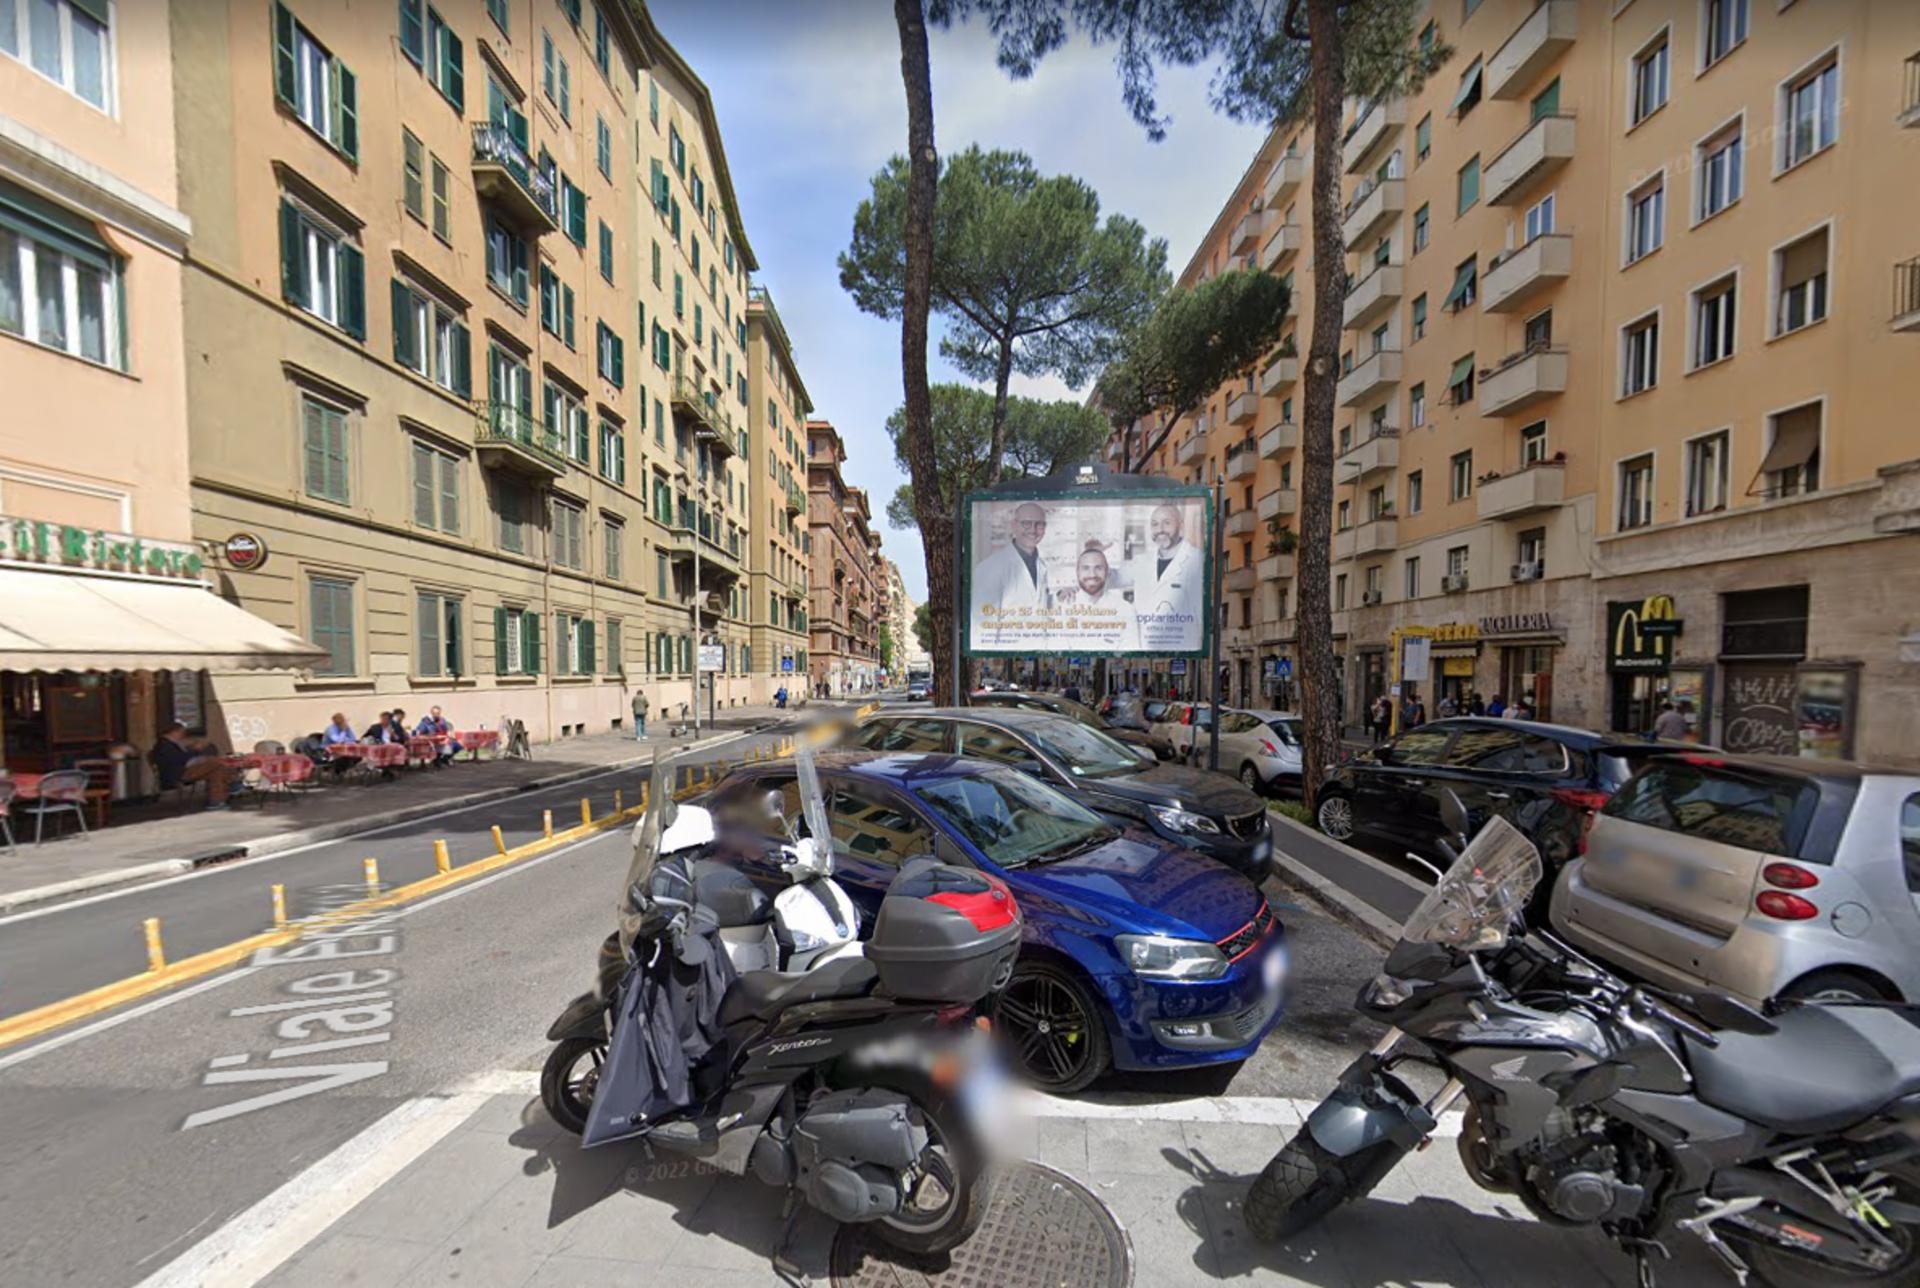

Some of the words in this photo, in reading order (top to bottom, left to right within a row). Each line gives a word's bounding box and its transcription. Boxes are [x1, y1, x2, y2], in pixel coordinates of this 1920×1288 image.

[15, 519, 48, 556] il
[63, 525, 203, 573] Ristoro
[981, 602, 1016, 619] Dopo
[1036, 606, 1061, 617] anni
[1065, 604, 1118, 617] abbiamo
[981, 620, 1024, 630] ancora
[1026, 618, 1063, 631] voglia
[1066, 618, 1078, 630] di
[1615, 658, 1663, 667] McDonald's
[768, 1038, 818, 1056] Xenter
